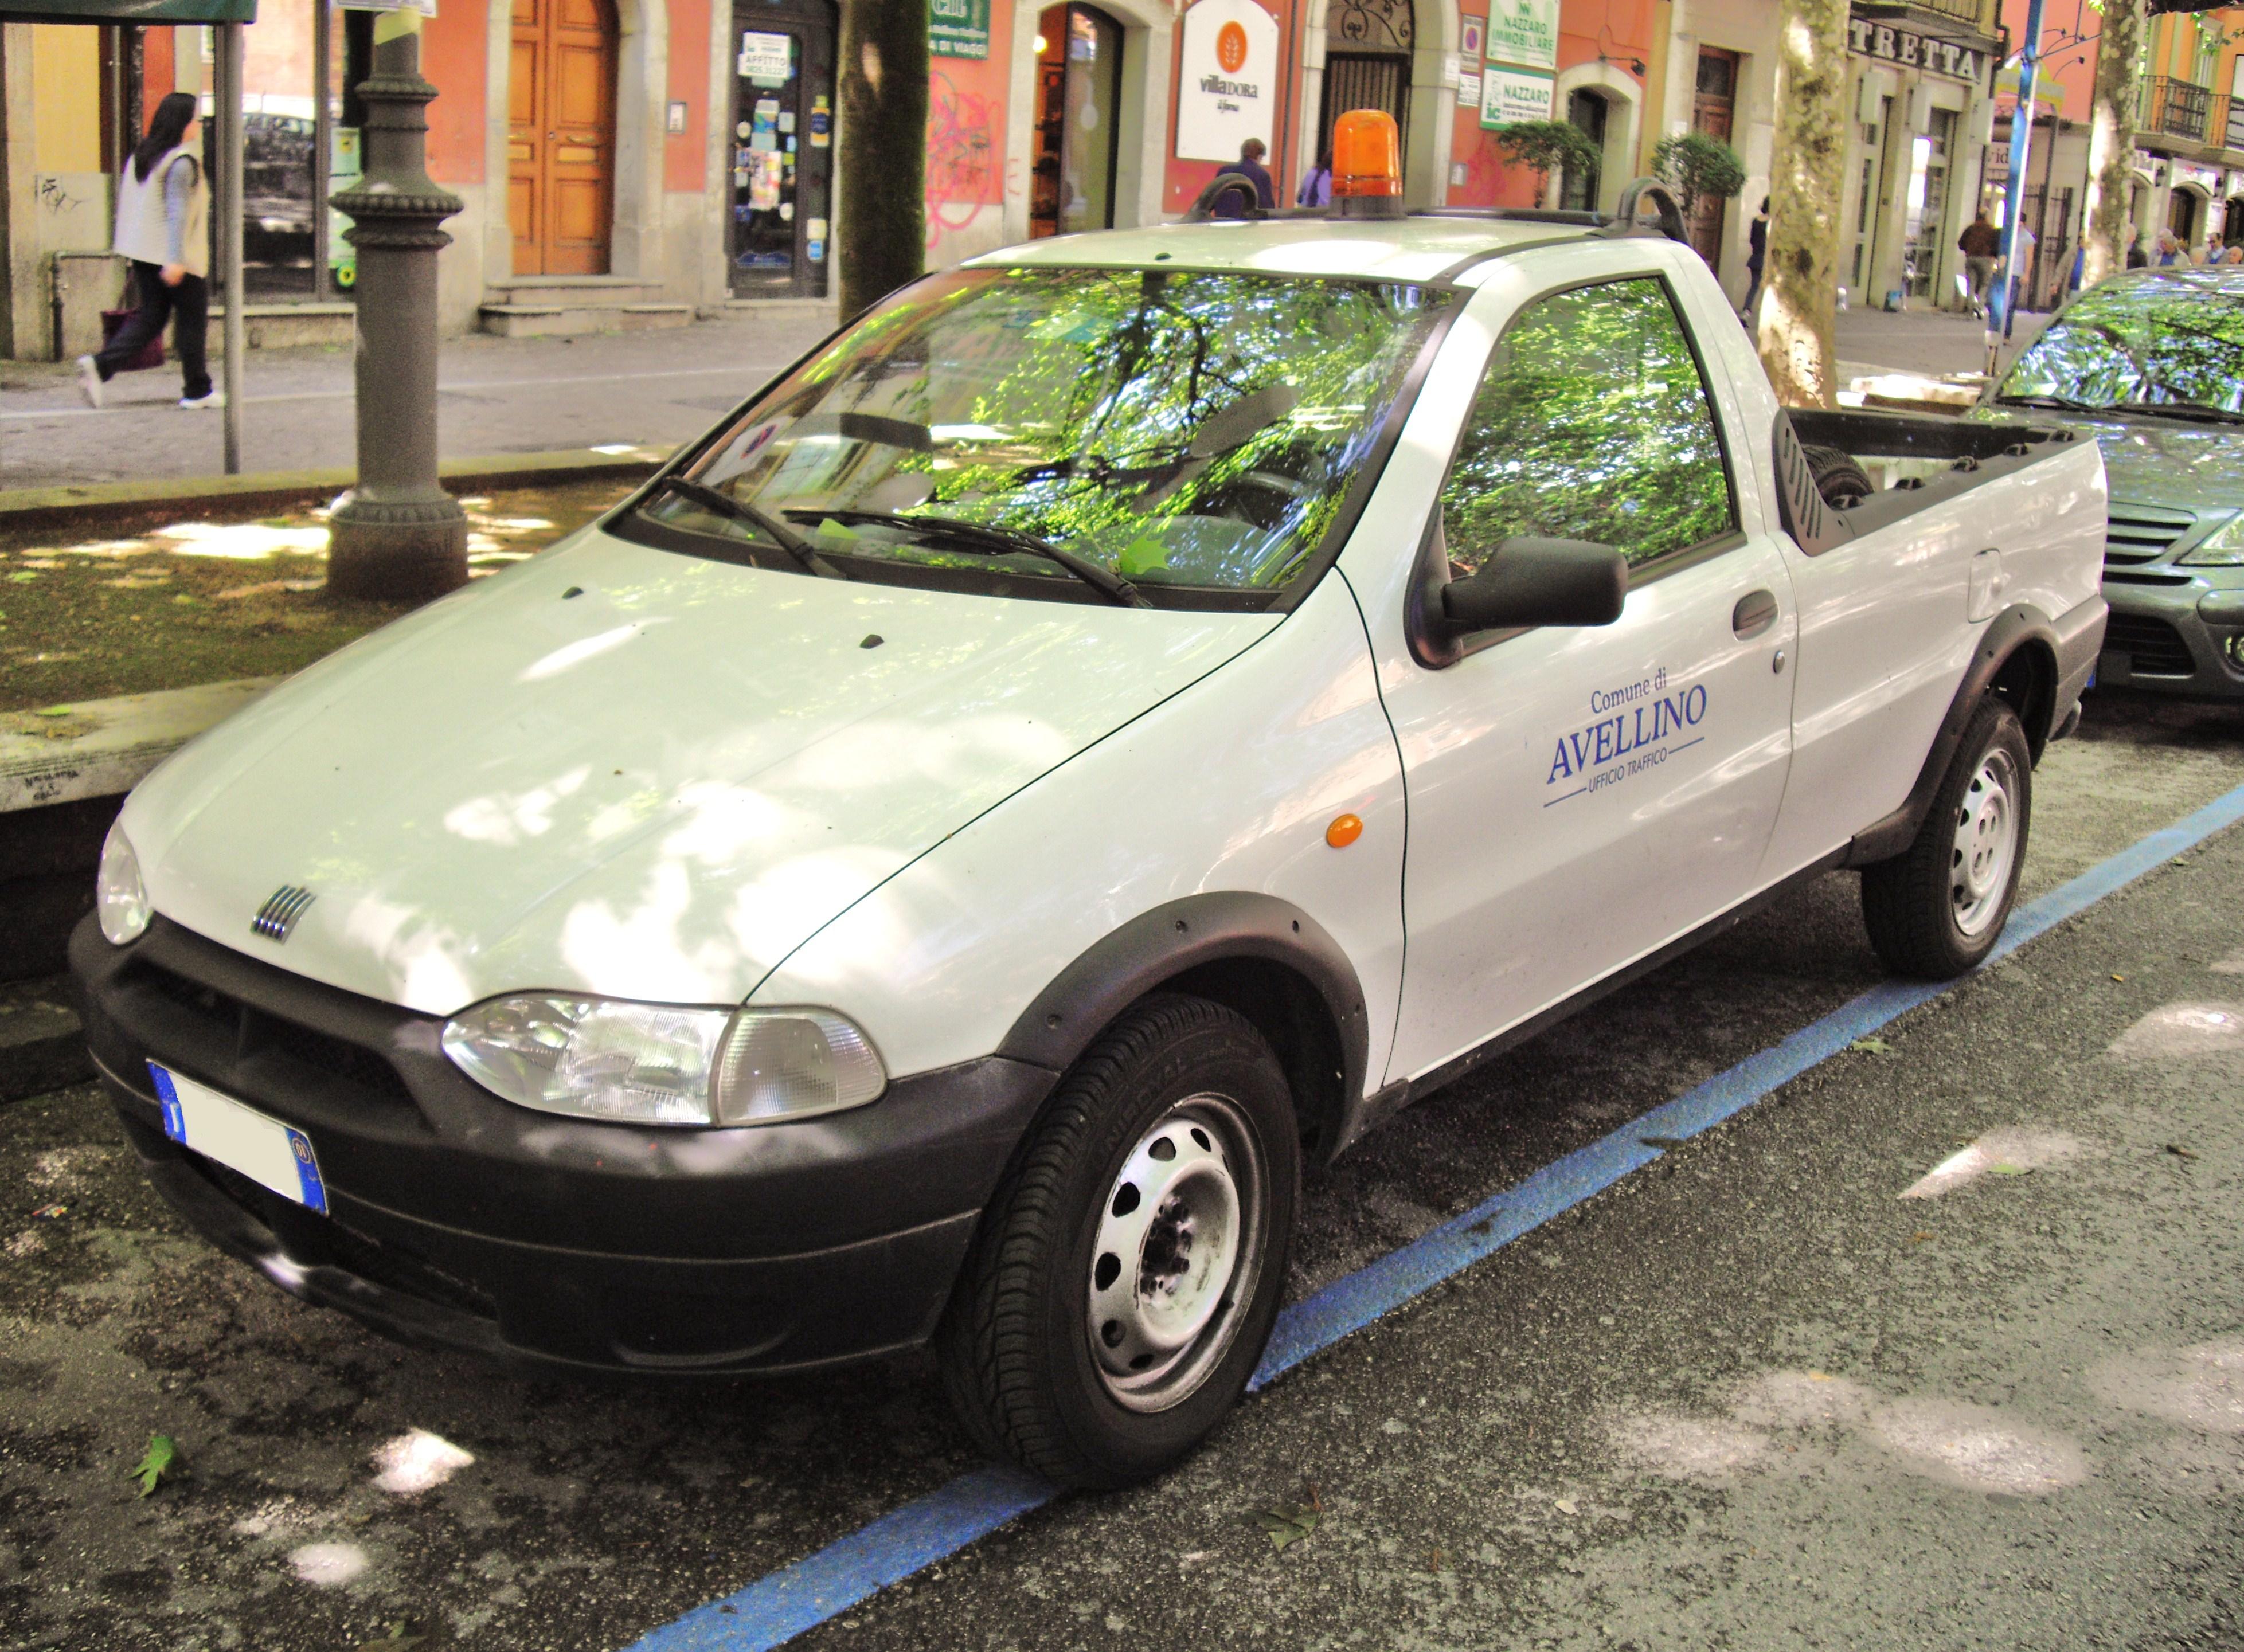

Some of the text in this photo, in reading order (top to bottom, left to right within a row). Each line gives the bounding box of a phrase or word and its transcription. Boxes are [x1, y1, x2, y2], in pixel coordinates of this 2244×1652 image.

[1504, 15, 1547, 34] NAZZARO
[939, 40, 950, 52] DI
[953, 42, 987, 56] VIAGGI
[1492, 28, 1553, 51] IMMOBILIARE
[746, 55, 785, 67] AFFITTO
[1503, 84, 1549, 104] NAZZARO
[1591, 666, 1667, 714] Comune di
[1546, 684, 1707, 785] AVELLINO
[1588, 747, 1667, 793] UFFICIO TRAFFICO
